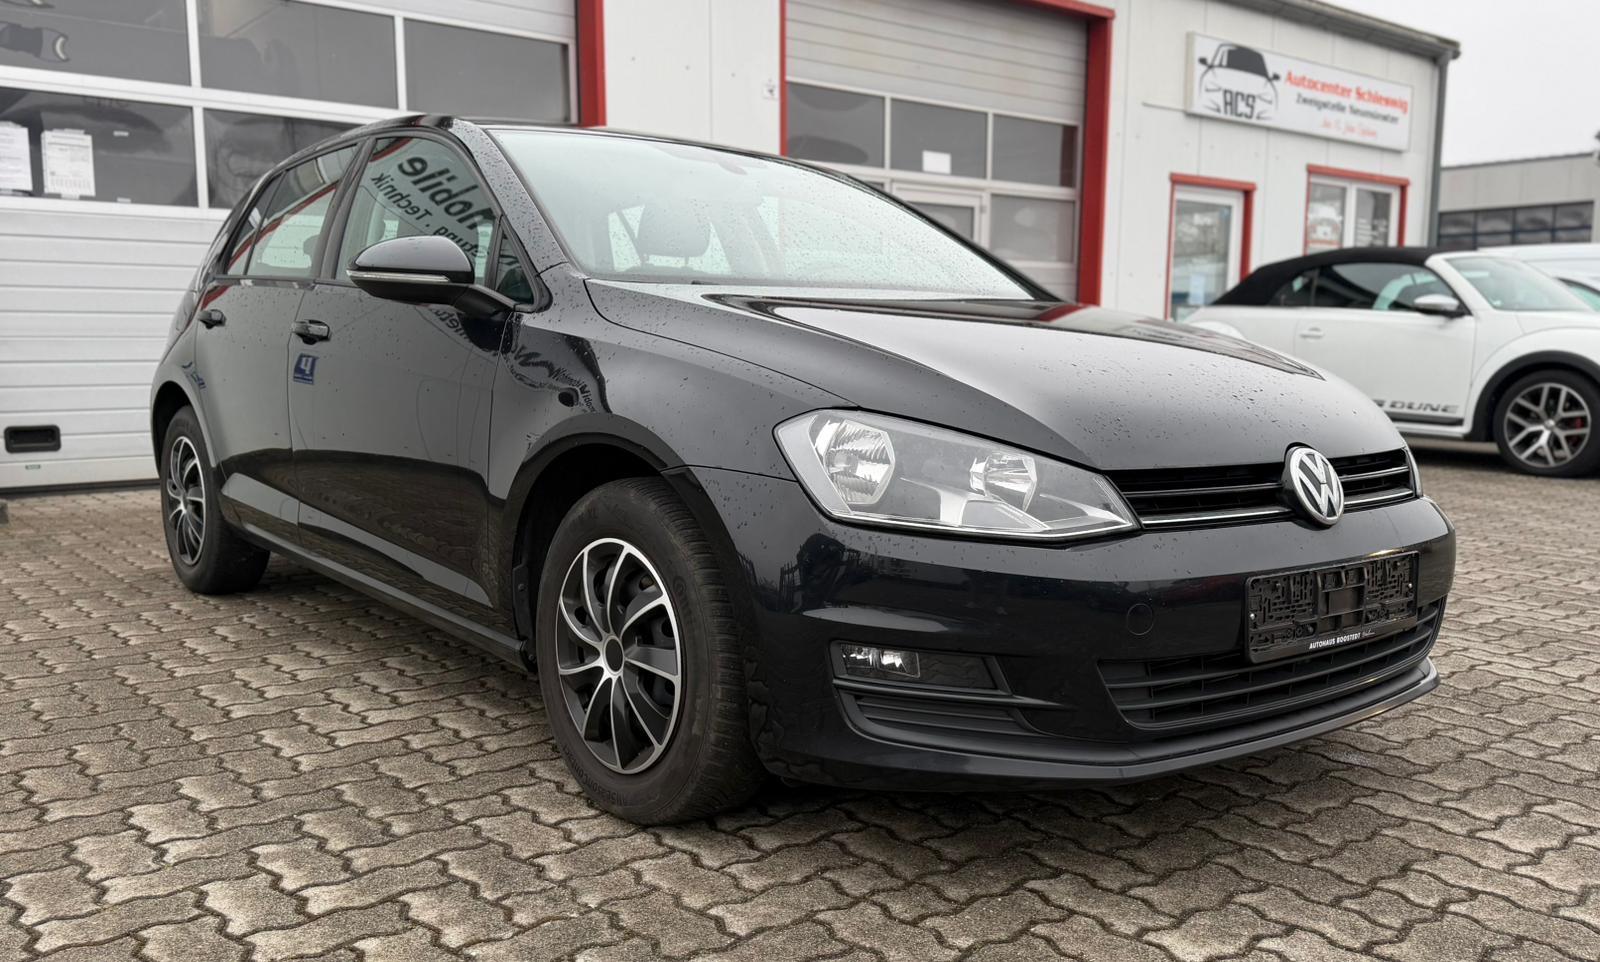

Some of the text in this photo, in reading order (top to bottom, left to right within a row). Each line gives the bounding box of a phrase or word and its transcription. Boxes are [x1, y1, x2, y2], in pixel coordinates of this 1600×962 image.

[1285, 72, 1353, 97] Autocenter
[1222, 88, 1256, 120] ACS
[1389, 400, 1459, 414] DUNE
[1309, 637, 1336, 650] AUTOHAUS
[1336, 632, 1361, 644] BOOSTEDT
